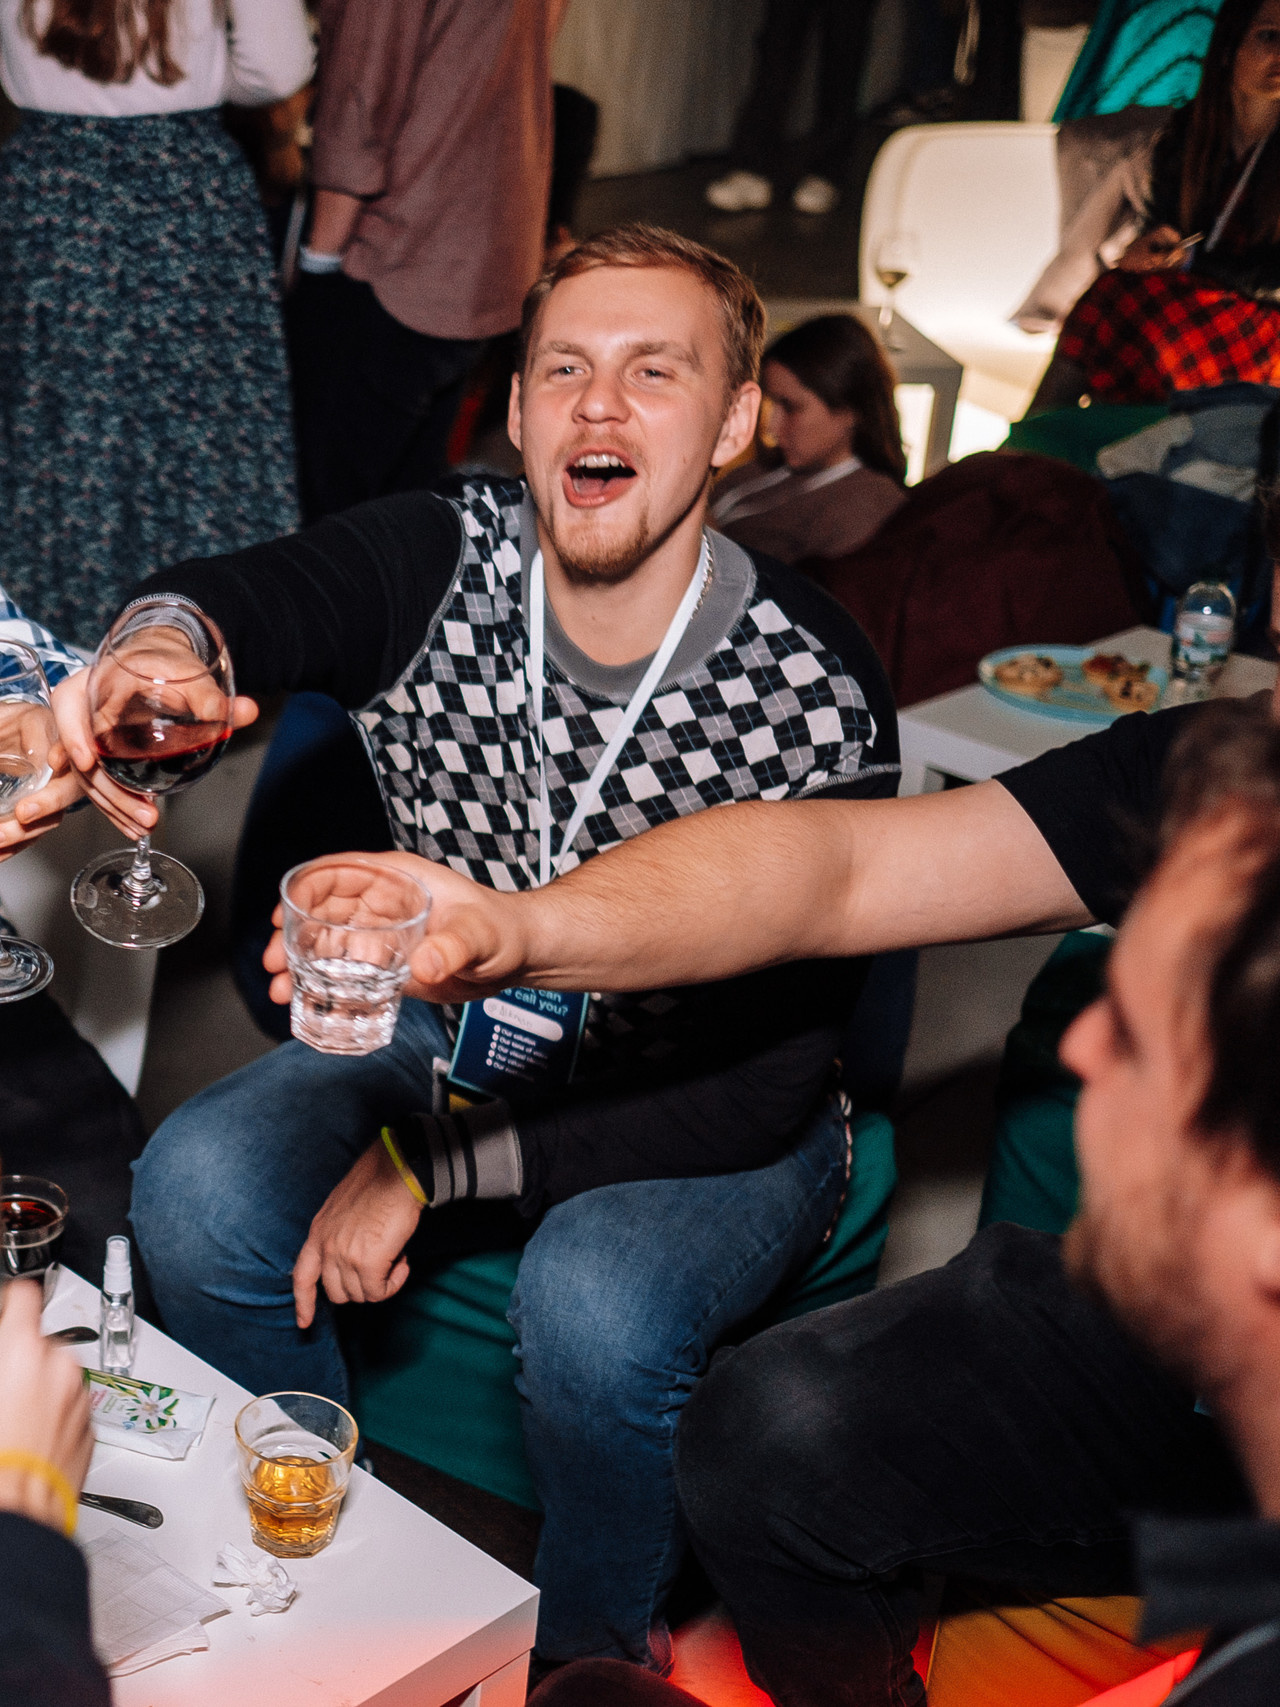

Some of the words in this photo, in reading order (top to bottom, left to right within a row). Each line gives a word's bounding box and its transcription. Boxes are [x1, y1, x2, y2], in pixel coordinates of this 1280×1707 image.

[538, 989, 562, 1003] can
[515, 990, 536, 1005] call
[539, 999, 569, 1017] you?
[501, 1028, 513, 1038] Our
[499, 1036, 511, 1046] Our
[497, 1044, 509, 1054] Our
[495, 1053, 507, 1062] Our
[493, 1061, 505, 1071] Our
